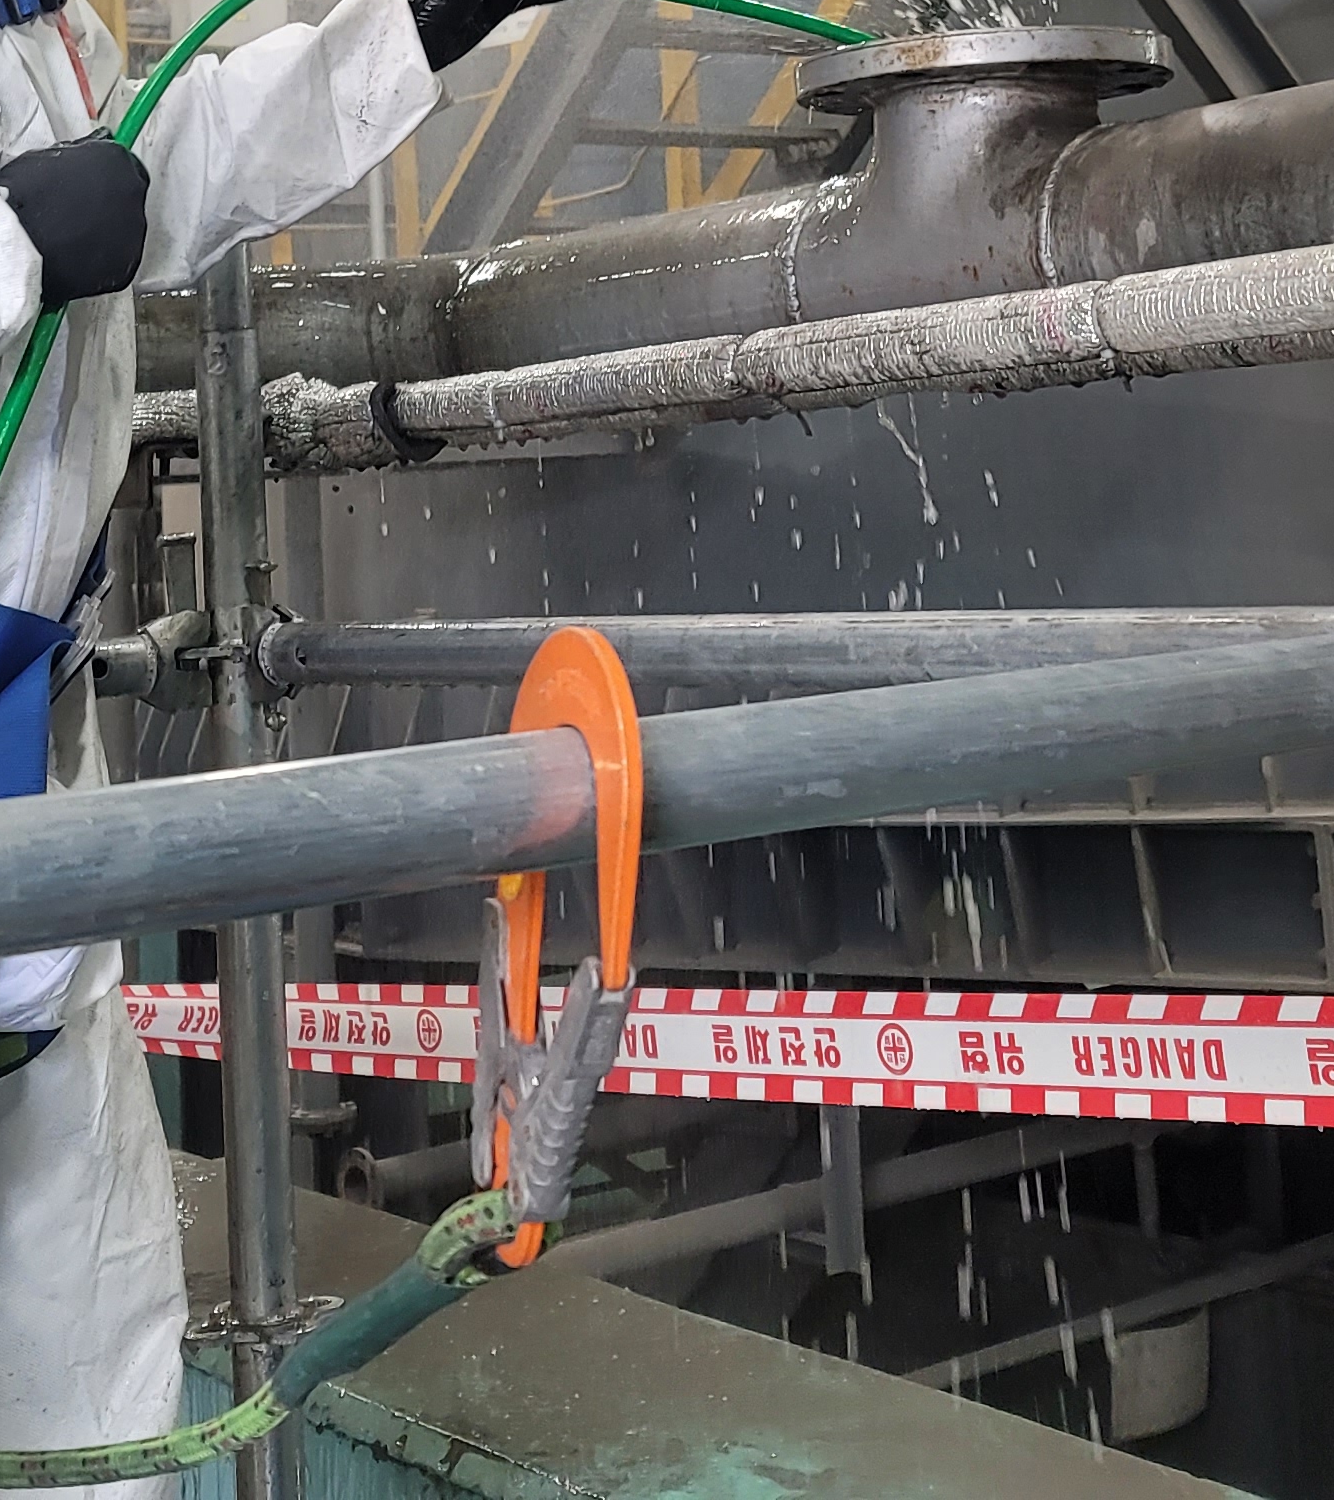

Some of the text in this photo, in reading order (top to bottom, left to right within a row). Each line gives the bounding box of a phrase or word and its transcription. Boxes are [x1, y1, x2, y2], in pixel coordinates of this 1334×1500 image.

[178, 1005, 220, 1035] GER
[298, 1008, 392, 1045] 안전제일
[712, 1023, 843, 1069] 안전제일
[957, 1030, 1026, 1076] 위험
[1071, 1035, 1228, 1082] DANGER
